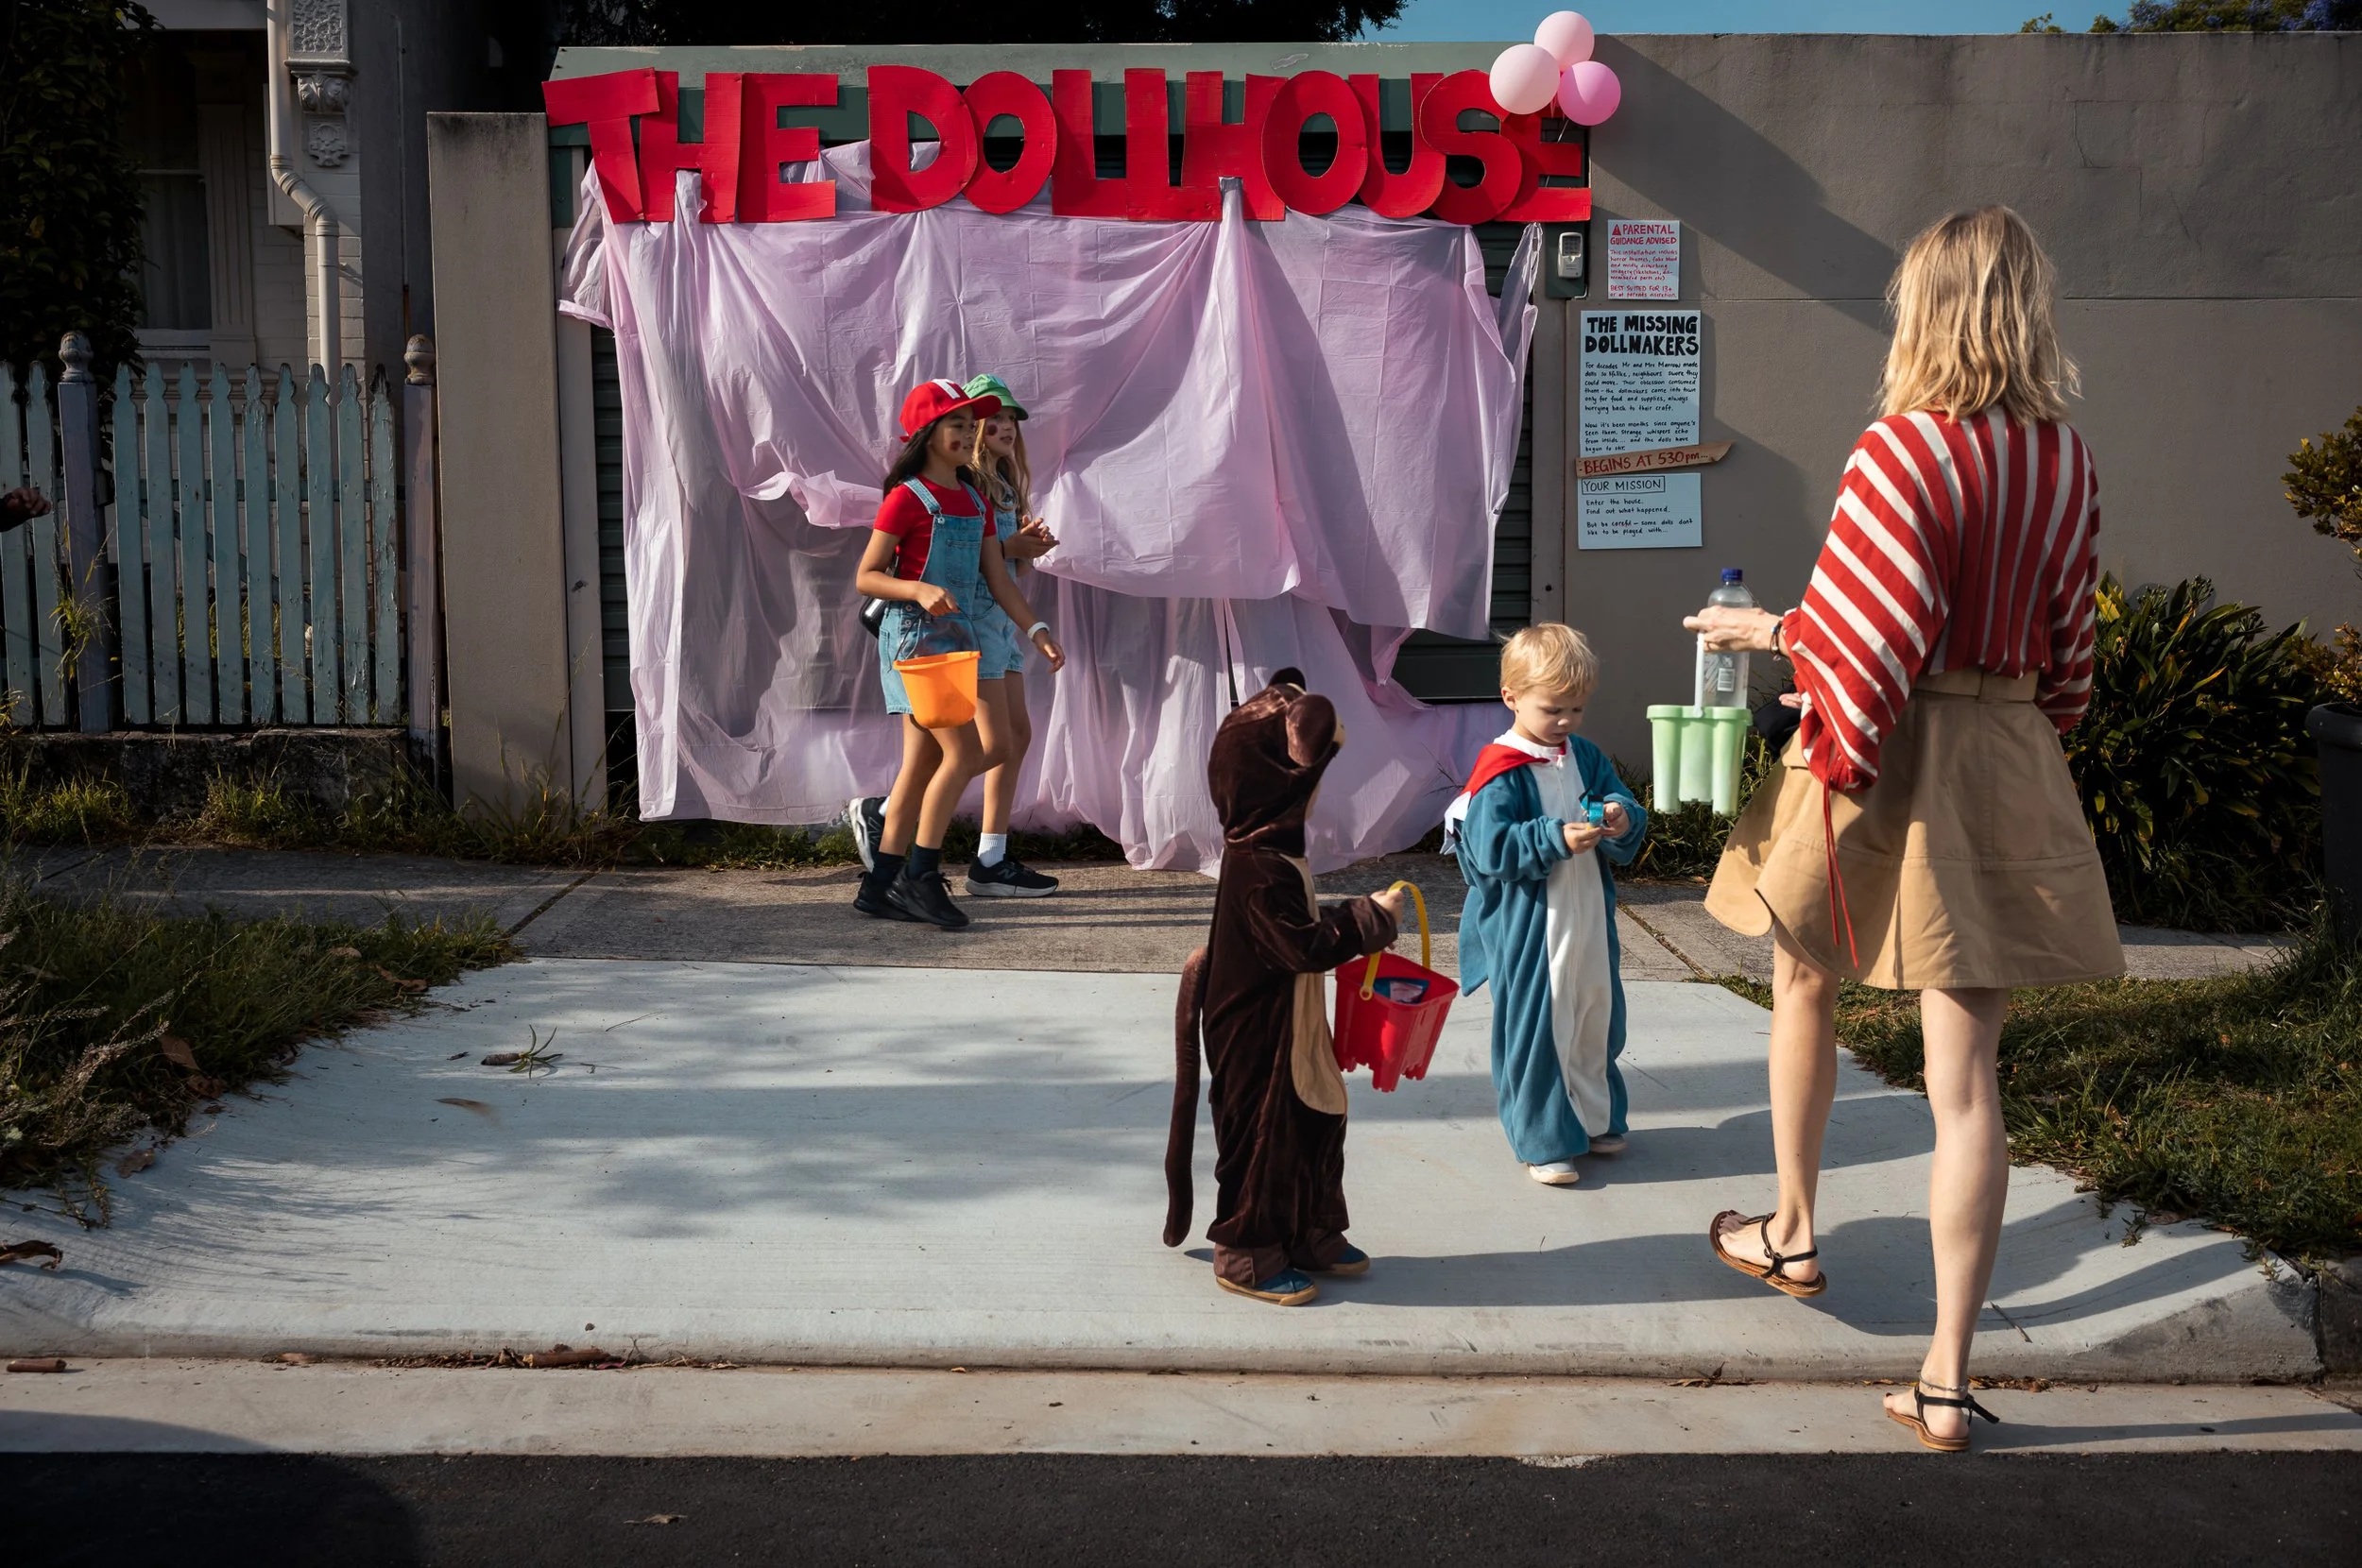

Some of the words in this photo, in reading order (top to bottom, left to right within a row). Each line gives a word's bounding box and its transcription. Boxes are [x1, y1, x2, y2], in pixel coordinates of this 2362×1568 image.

[541, 67, 839, 224] THE
[866, 64, 1591, 223] DOLLHOUSE
[1623, 224, 1674, 234] PARENTAL
[1587, 316, 1617, 332] THE
[1624, 315, 1698, 333] MISSING
[1585, 334, 1699, 356] DOLLMAKERS
[1670, 420, 1695, 429] anyone's
[1583, 457, 1631, 474] BEGINS
[1636, 454, 1652, 468] AT
[1583, 481, 1609, 491] YOUR
[1616, 479, 1661, 490] MISSION
[1623, 528, 1642, 537] played
